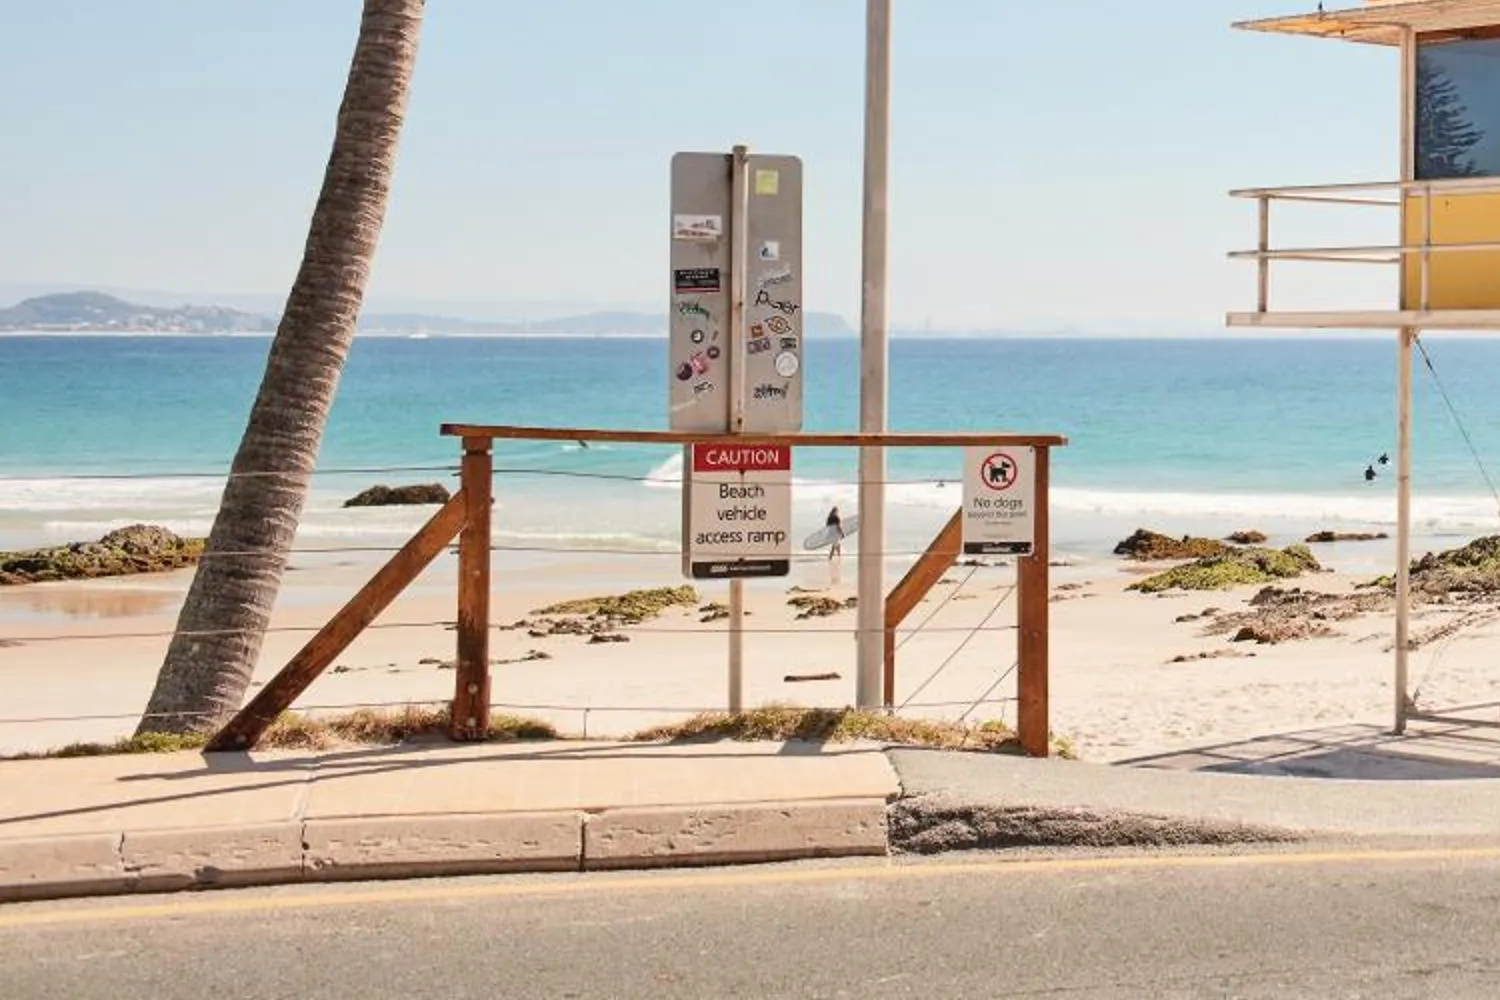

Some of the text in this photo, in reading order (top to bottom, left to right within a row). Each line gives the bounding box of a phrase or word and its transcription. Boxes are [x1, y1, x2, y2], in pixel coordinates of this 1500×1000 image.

[706, 449, 779, 465] CAUTION
[719, 483, 764, 499] Beach
[973, 497, 1023, 511] No dogs
[717, 505, 767, 521] vehicle
[696, 530, 785, 547] access ramp
